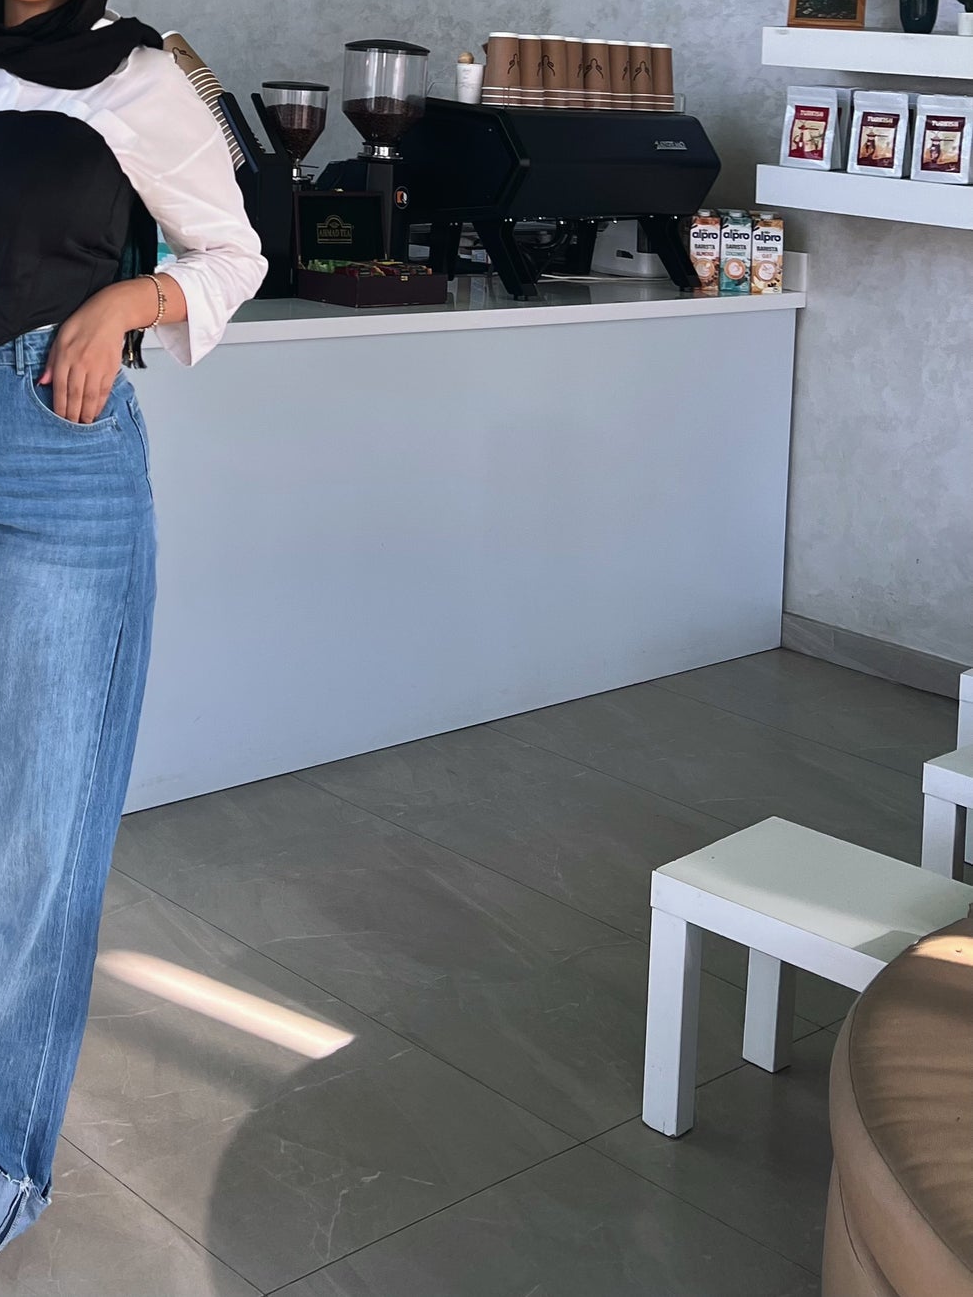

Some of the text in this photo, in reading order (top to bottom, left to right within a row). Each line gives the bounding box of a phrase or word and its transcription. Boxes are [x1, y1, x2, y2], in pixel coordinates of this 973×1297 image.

[692, 229, 719, 241] alpro
[723, 229, 749, 241] alpro
[754, 231, 781, 243] alpro
